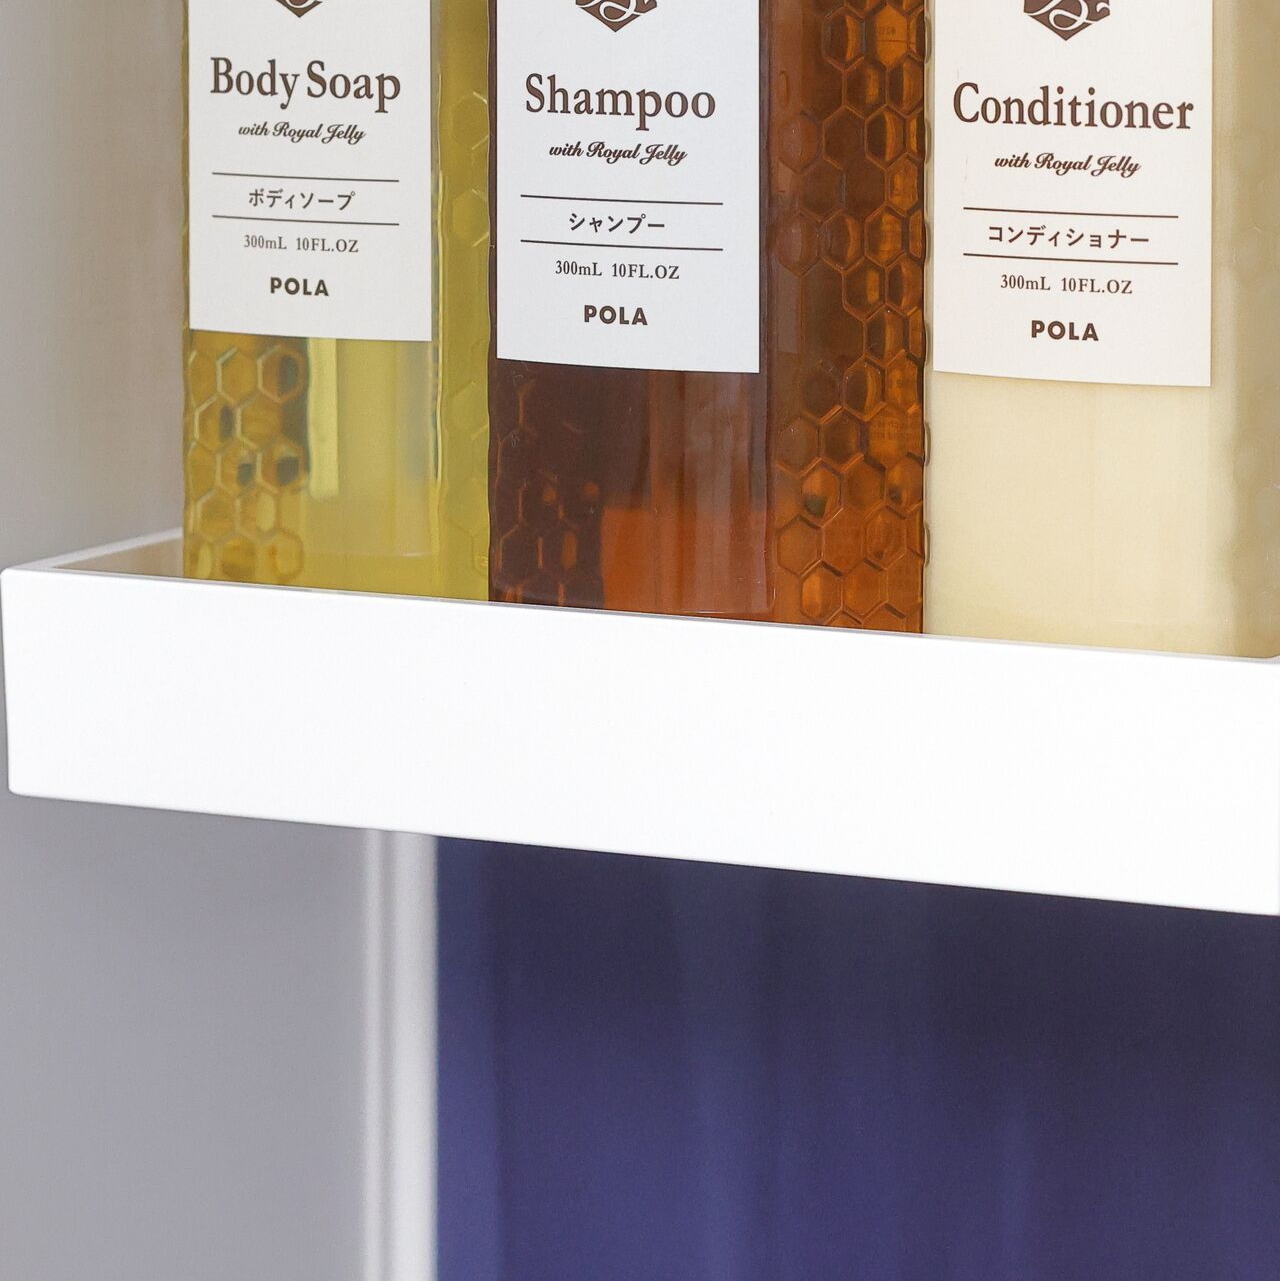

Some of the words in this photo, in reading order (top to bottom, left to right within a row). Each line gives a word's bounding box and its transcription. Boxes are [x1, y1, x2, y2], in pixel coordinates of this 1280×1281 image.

[210, 57, 300, 110] Body
[307, 60, 400, 113] Soap
[526, 73, 715, 131] Shampoo
[953, 82, 1194, 129] Conditioner
[238, 121, 270, 136] with
[272, 122, 322, 143] Royal
[322, 123, 366, 145] Jelly
[549, 141, 584, 157] with
[586, 141, 641, 164] Royal
[640, 143, 688, 166] Jelly
[994, 152, 1032, 168] with
[1034, 153, 1093, 176] Royal
[1091, 155, 1141, 178] Jelly
[249, 188, 355, 210] ボディソープ
[569, 213, 665, 234] シャンプー
[244, 235, 287, 249] 300mL
[296, 237, 358, 253] 10FL.OZ
[989, 225, 1149, 249] コンディショナー
[555, 260, 602, 276] 300mL
[612, 263, 679, 279] 10FL.OZ
[270, 277, 329, 296] POLA
[1001, 274, 1050, 290] 300mL
[1061, 277, 1132, 294] 10FL.OZ
[584, 305, 648, 325] POLA
[1031, 320, 1099, 341] POLA
